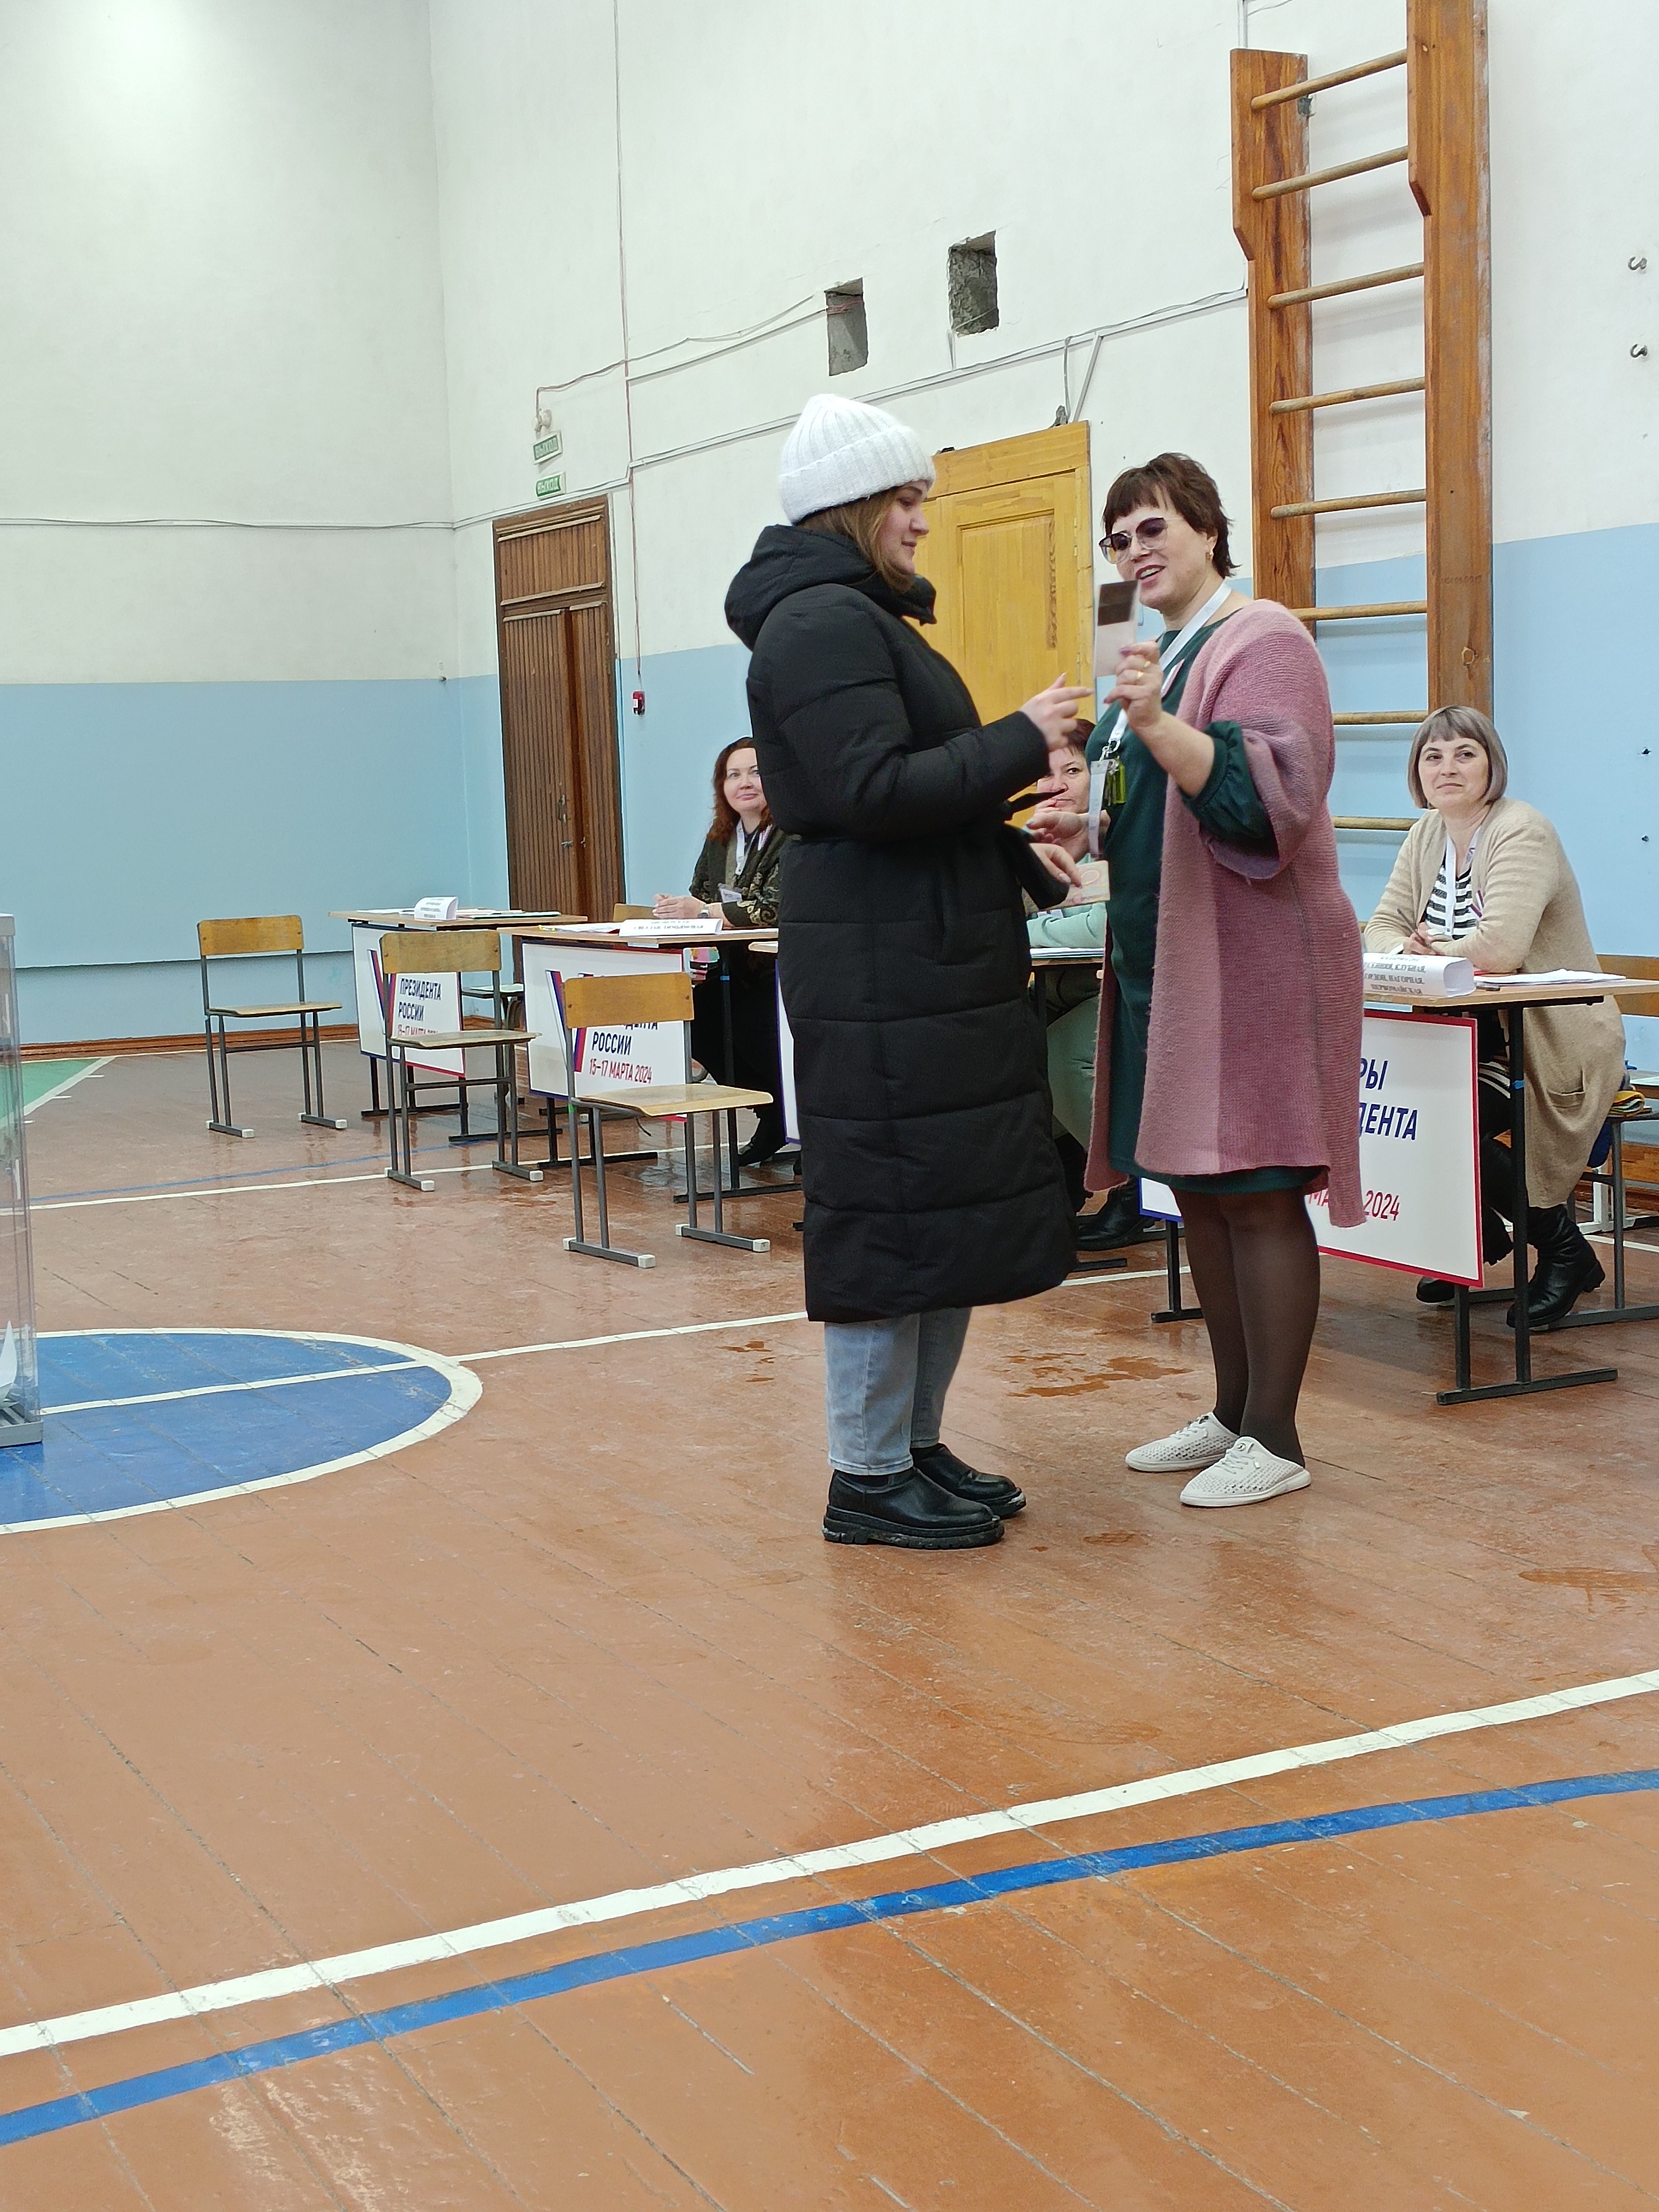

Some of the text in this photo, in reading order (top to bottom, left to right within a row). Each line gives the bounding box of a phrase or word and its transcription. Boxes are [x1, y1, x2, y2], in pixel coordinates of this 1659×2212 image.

[398, 1001, 424, 1022] РОССИИ
[591, 1031, 632, 1056] РОССИИ
[609, 1061, 633, 1081] МАРТА
[634, 1064, 652, 1084] 2024
[1363, 1190, 1400, 1221] 2024
